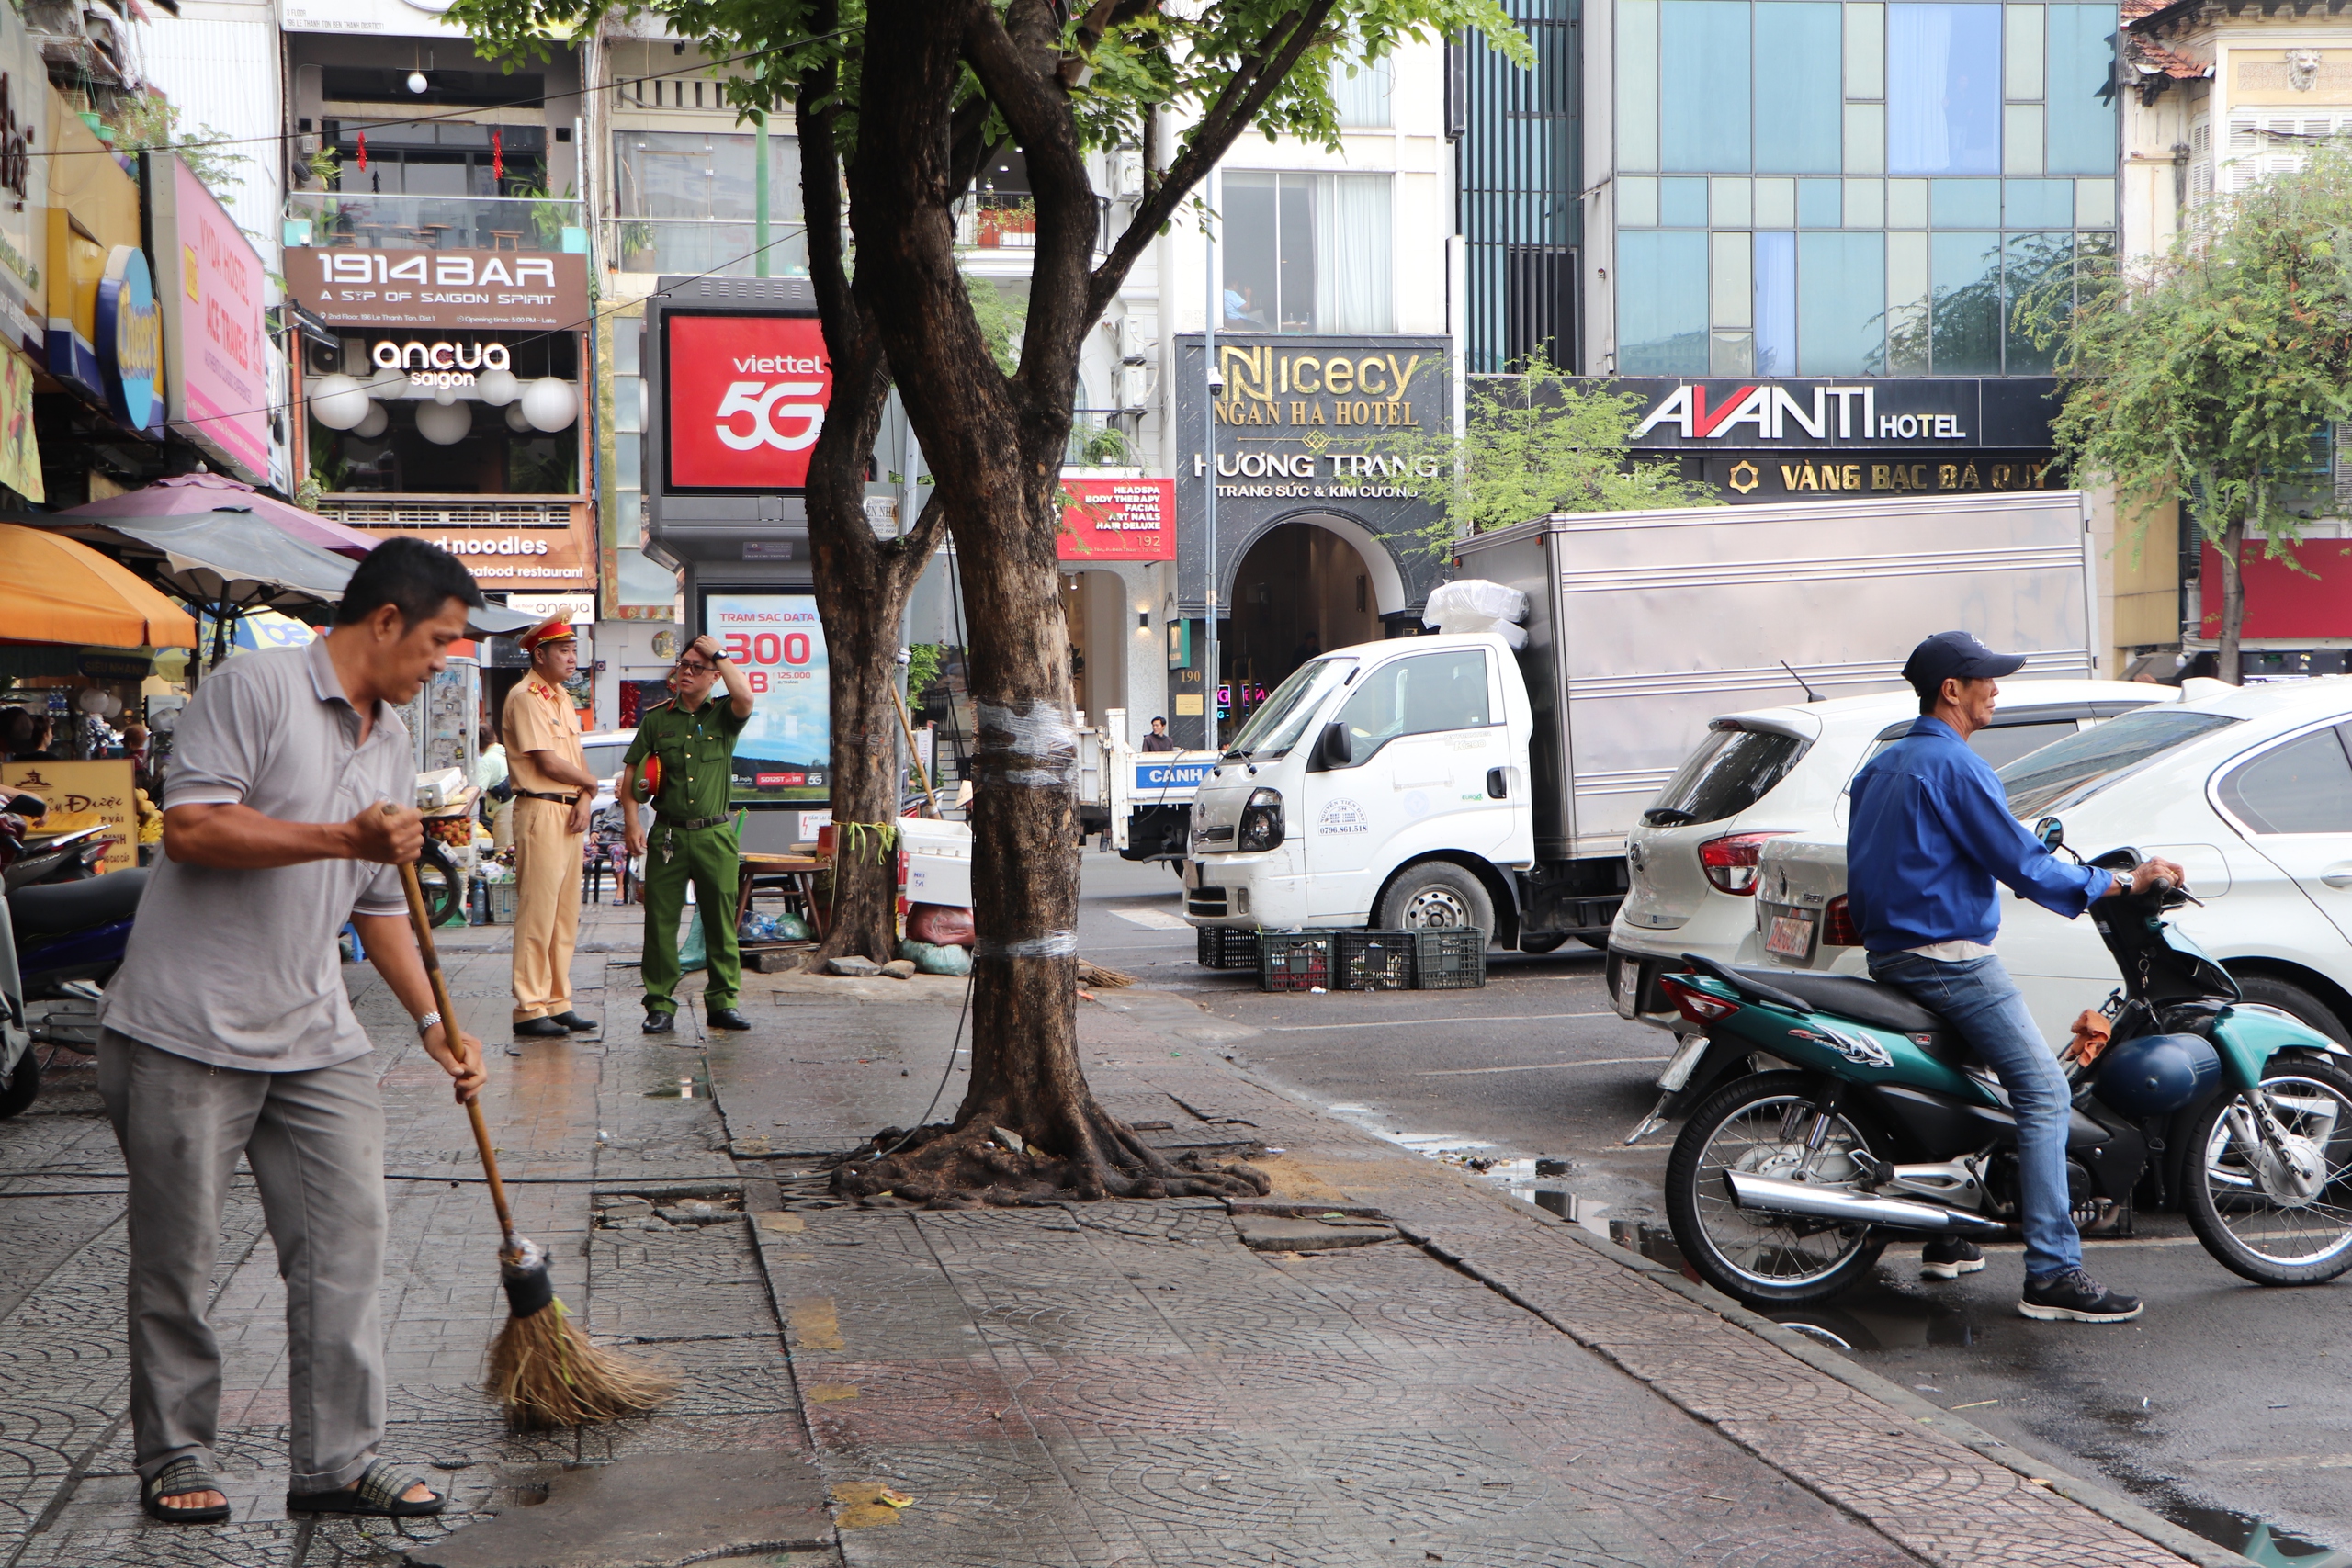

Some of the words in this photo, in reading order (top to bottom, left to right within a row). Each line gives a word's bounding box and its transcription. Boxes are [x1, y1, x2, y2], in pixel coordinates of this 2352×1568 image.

[318, 254, 428, 285] 1914
[436, 256, 556, 288] BAR
[320, 290, 333, 301] A
[385, 292, 412, 302] OF
[421, 292, 490, 304] SAIGON
[497, 294, 556, 305] SPIRIT
[465, 315, 493, 324] Opening
[373, 340, 511, 371] ancua
[733, 355, 825, 374] viettel
[411, 371, 475, 389] saigon
[715, 381, 826, 452] 5G
[1214, 401, 1281, 425] NGAN
[1290, 401, 1326, 425] HA
[1335, 401, 1419, 426] HOTEL
[1628, 384, 1875, 439] AVANTI
[1880, 413, 1967, 438] HOTEL
[1781, 458, 1861, 491] VÀNG
[1871, 464, 1928, 494] BẠC
[1113, 486, 1160, 494] HEADSPA
[1216, 484, 1272, 498] TRANG
[1275, 481, 1310, 498] SỨC
[1314, 486, 1324, 497] &
[1329, 485, 1356, 497] KIM
[1085, 495, 1113, 503] BODY
[1114, 495, 1160, 503] THERAPY
[1125, 503, 1160, 512] FACIAL
[1108, 513, 1129, 521] ART
[1130, 513, 1161, 521] NAILS
[1096, 522, 1121, 530] HAIR
[1122, 522, 1161, 530] DELUXE
[453, 536, 548, 555] noodles
[1137, 536, 1161, 547] 192
[467, 565, 514, 578] eafood
[517, 566, 584, 579] restaurant
[783, 613, 816, 622] DATA
[724, 632, 811, 665] 300
[1181, 671, 1202, 682] 190
[1148, 768, 1203, 783] CANH
[2254, 1103, 2303, 1176] HONDA
